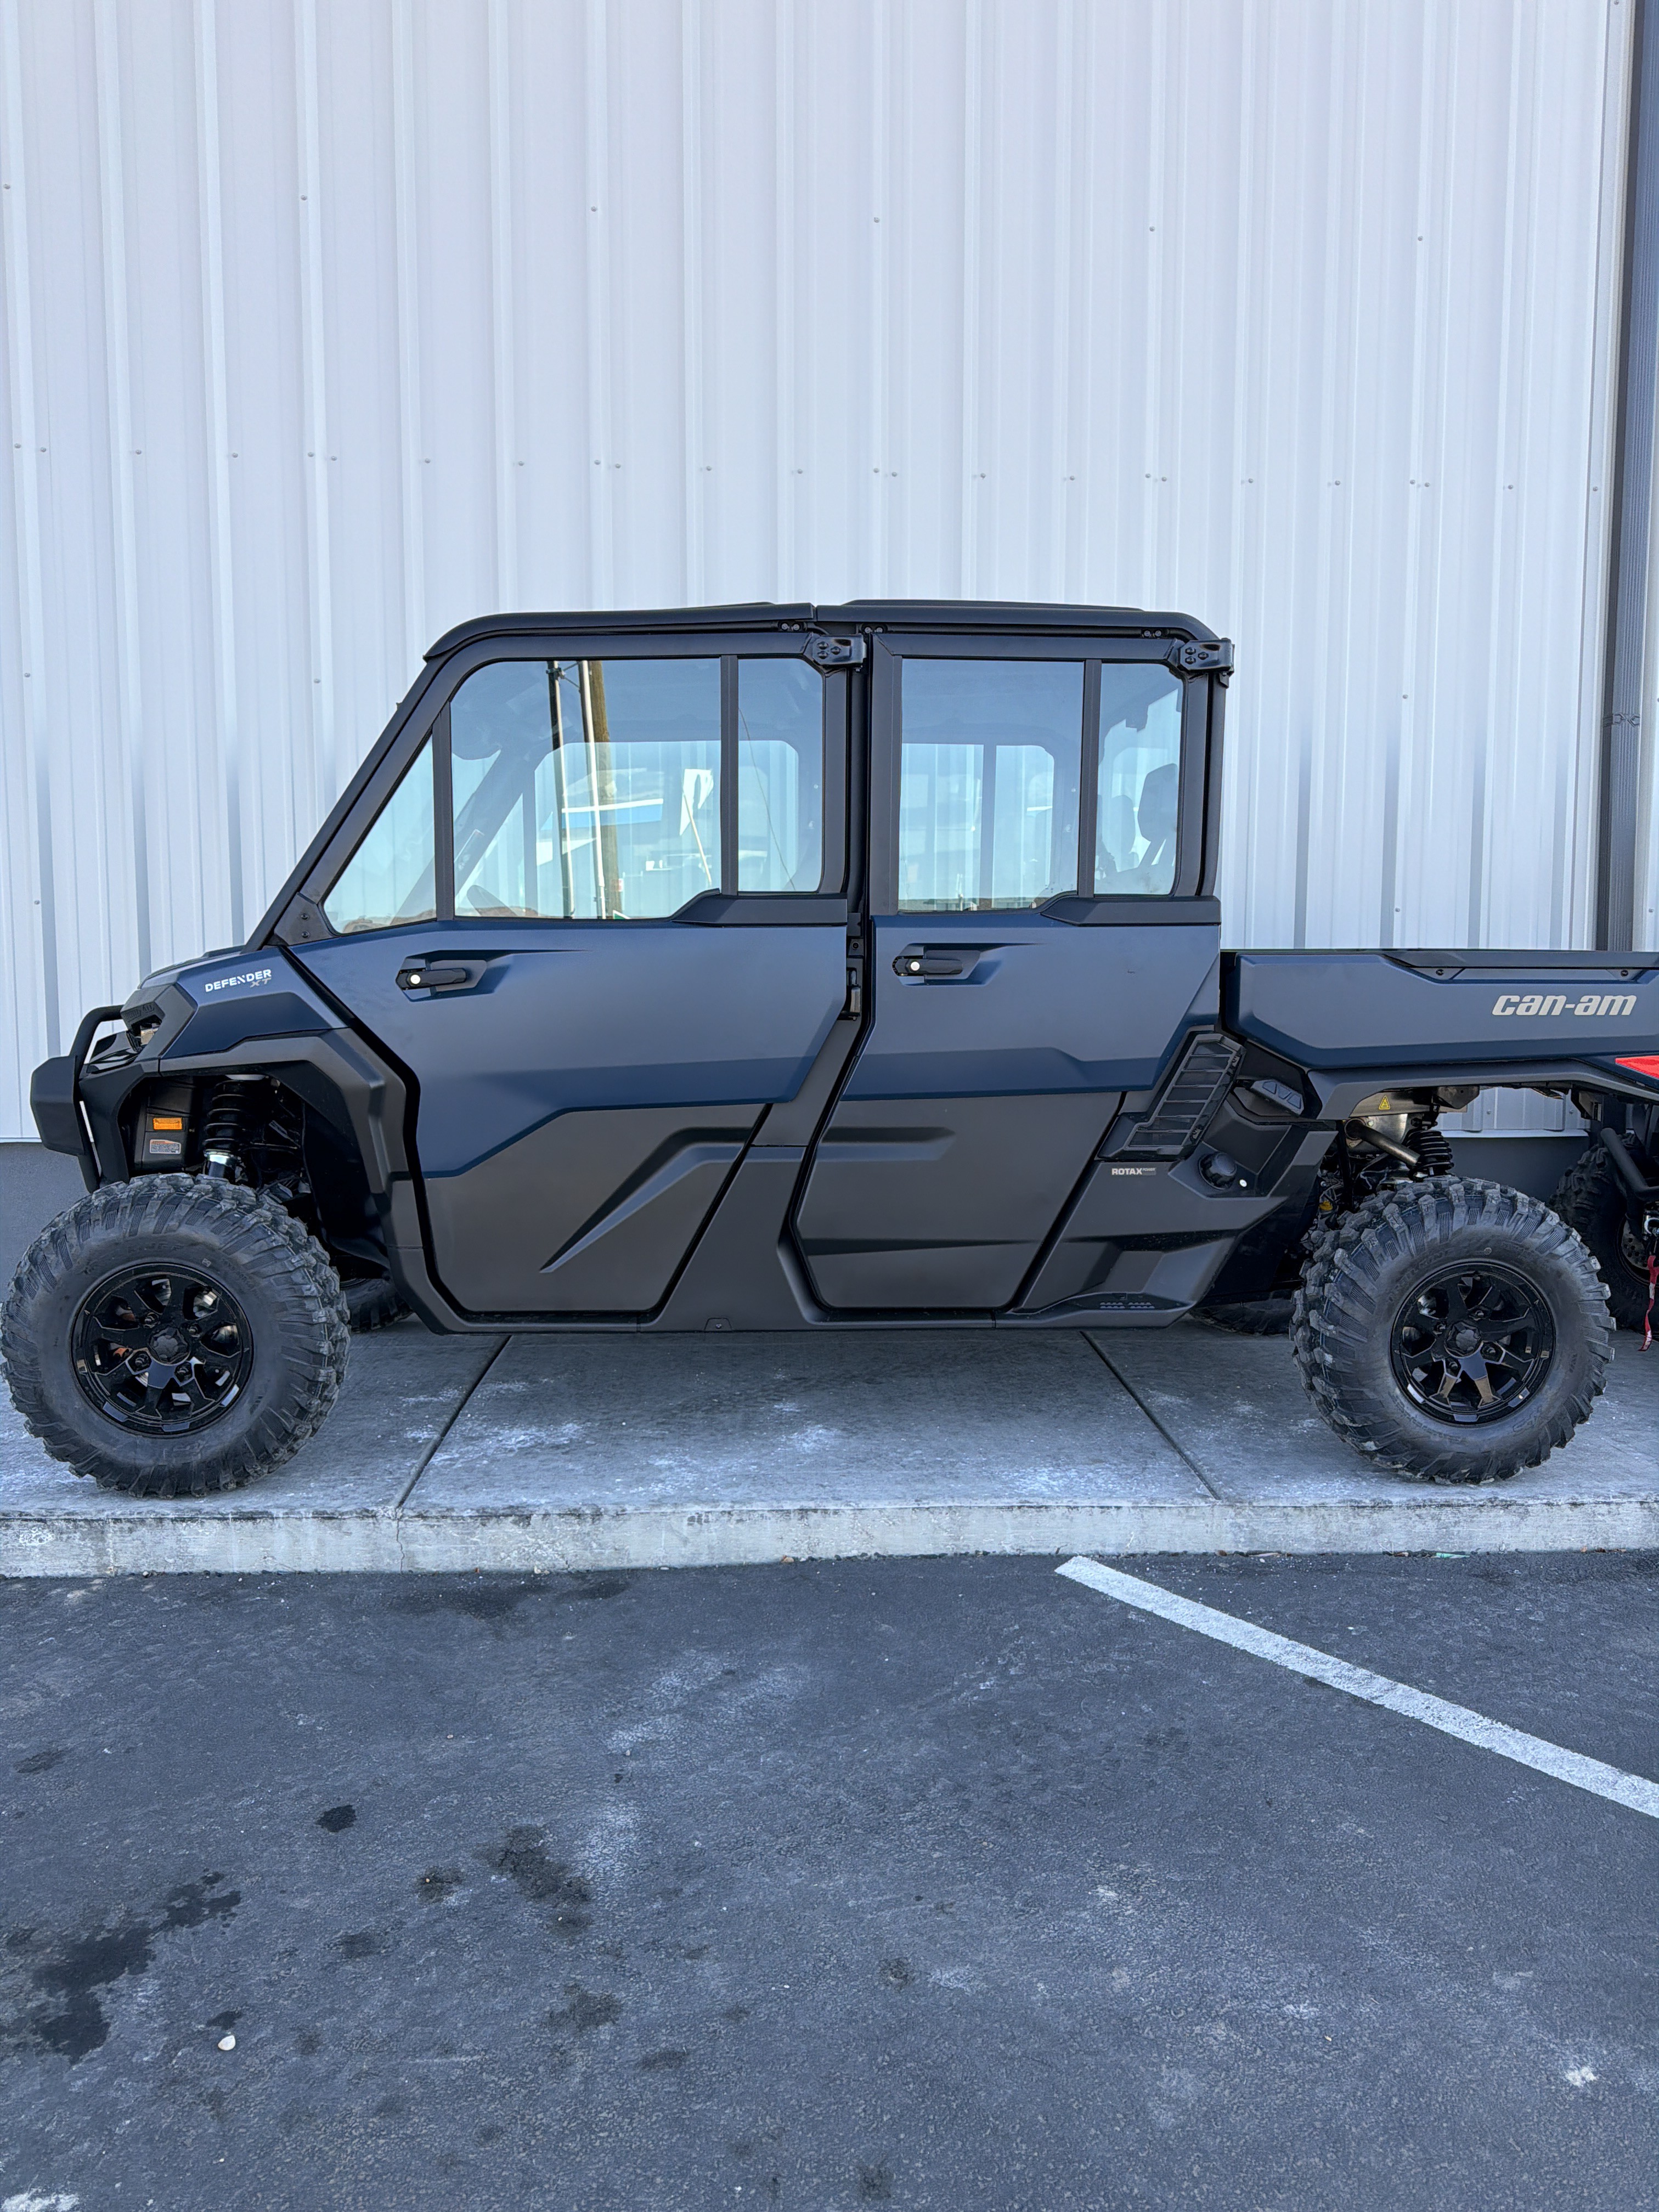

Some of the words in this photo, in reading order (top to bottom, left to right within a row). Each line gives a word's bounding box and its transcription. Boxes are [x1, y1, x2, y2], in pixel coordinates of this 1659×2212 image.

[205, 969, 272, 992] DEFENDER
[250, 978, 272, 988] XT
[1492, 995, 1637, 1015] can-am
